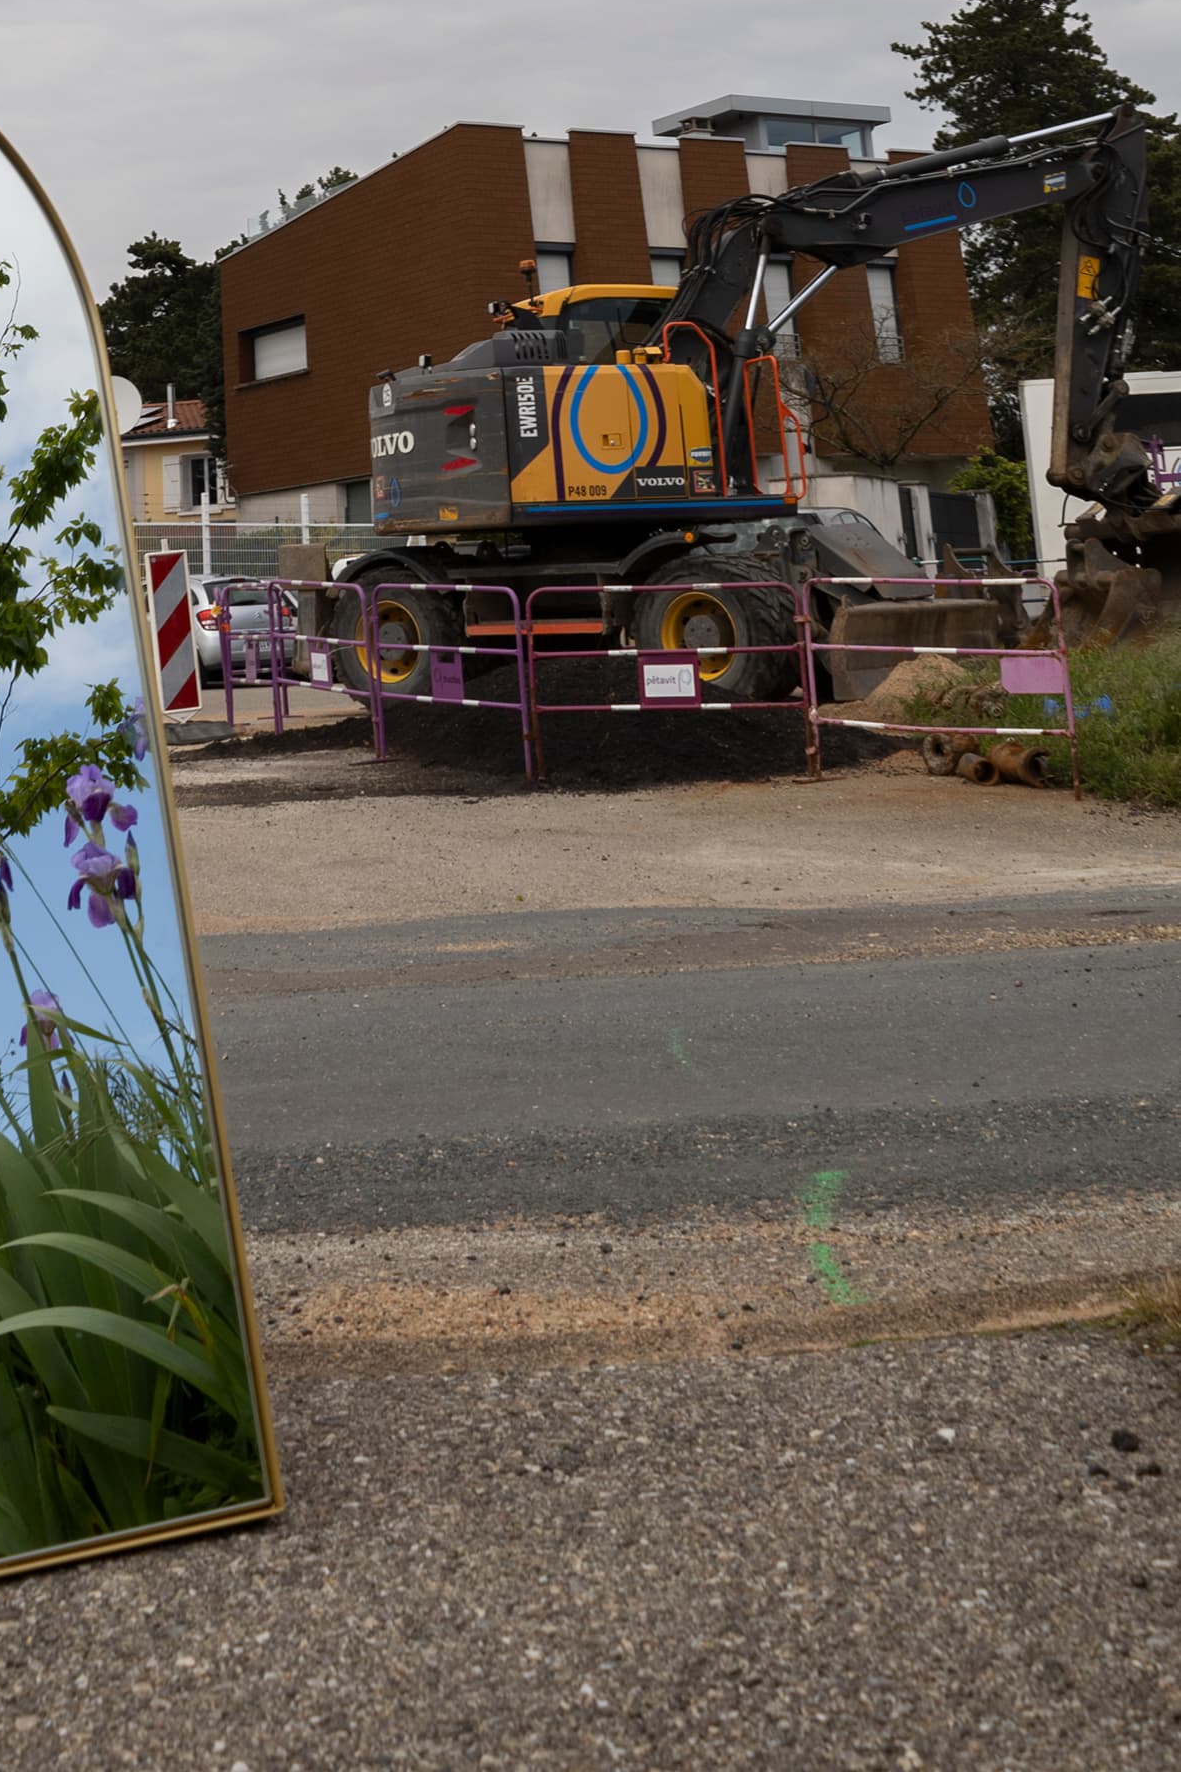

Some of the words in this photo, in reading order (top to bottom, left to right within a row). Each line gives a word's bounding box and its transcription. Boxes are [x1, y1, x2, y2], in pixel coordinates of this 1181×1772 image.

[515, 376, 538, 438] EWR150E
[371, 431, 415, 458] OLVO
[568, 485, 587, 496] P48
[589, 484, 607, 496] 009
[636, 477, 685, 486] VOLVO
